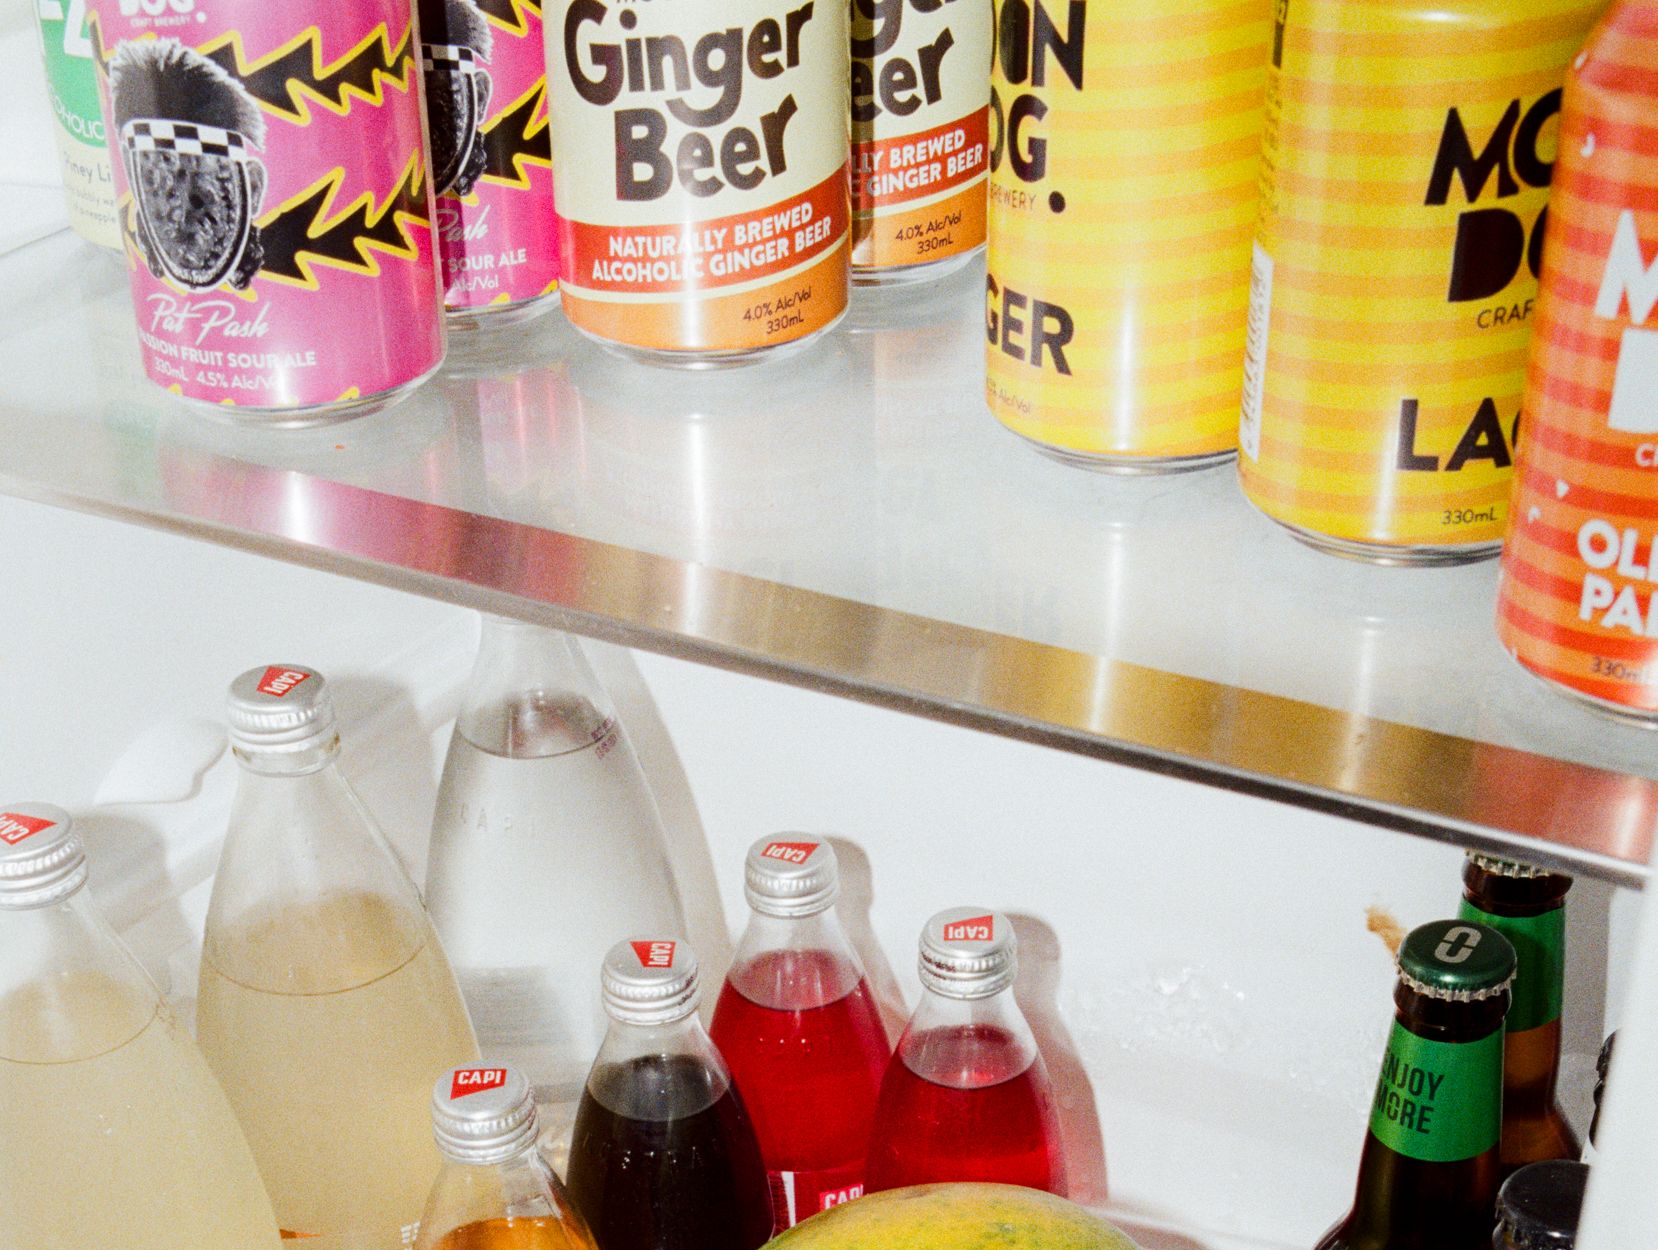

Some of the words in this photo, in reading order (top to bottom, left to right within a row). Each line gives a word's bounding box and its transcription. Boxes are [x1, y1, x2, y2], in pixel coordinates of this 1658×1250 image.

[989, 0, 1086, 91] ON
[564, 0, 814, 127] Ginger
[614, 93, 798, 201] Beer
[890, 128, 966, 169] BREWED
[866, 166, 941, 197] GINGER
[947, 143, 983, 178] BEER
[609, 227, 727, 258] NATURALLY
[734, 202, 812, 246] BREWED
[895, 223, 924, 242] 4.0%
[926, 210, 962, 234] Alc/Vol
[448, 254, 494, 273] SOUR
[498, 248, 527, 267] ALE
[592, 256, 704, 283] ALCOHOLIC
[709, 237, 789, 277] GINGER
[795, 216, 831, 254] BEER
[917, 233, 954, 254] 330mL
[147, 293, 201, 332] Pat
[191, 300, 270, 346] Pash
[742, 302, 773, 322] 4.0%
[775, 286, 812, 313] Alc/Vol
[766, 309, 805, 335] 330mL
[141, 329, 178, 358] SSION
[181, 346, 223, 366] FRUIT
[283, 351, 316, 367] ALE
[154, 356, 188, 381] 330mL
[196, 369, 228, 388] 4.5%
[1396, 397, 1520, 472] LA
[1441, 506, 1497, 525] 330mL
[263, 671, 304, 693] CAPI
[766, 844, 806, 862] CAPI
[948, 926, 988, 939] CAPI
[648, 943, 672, 965] CAPI
[458, 1070, 502, 1084] CAPI
